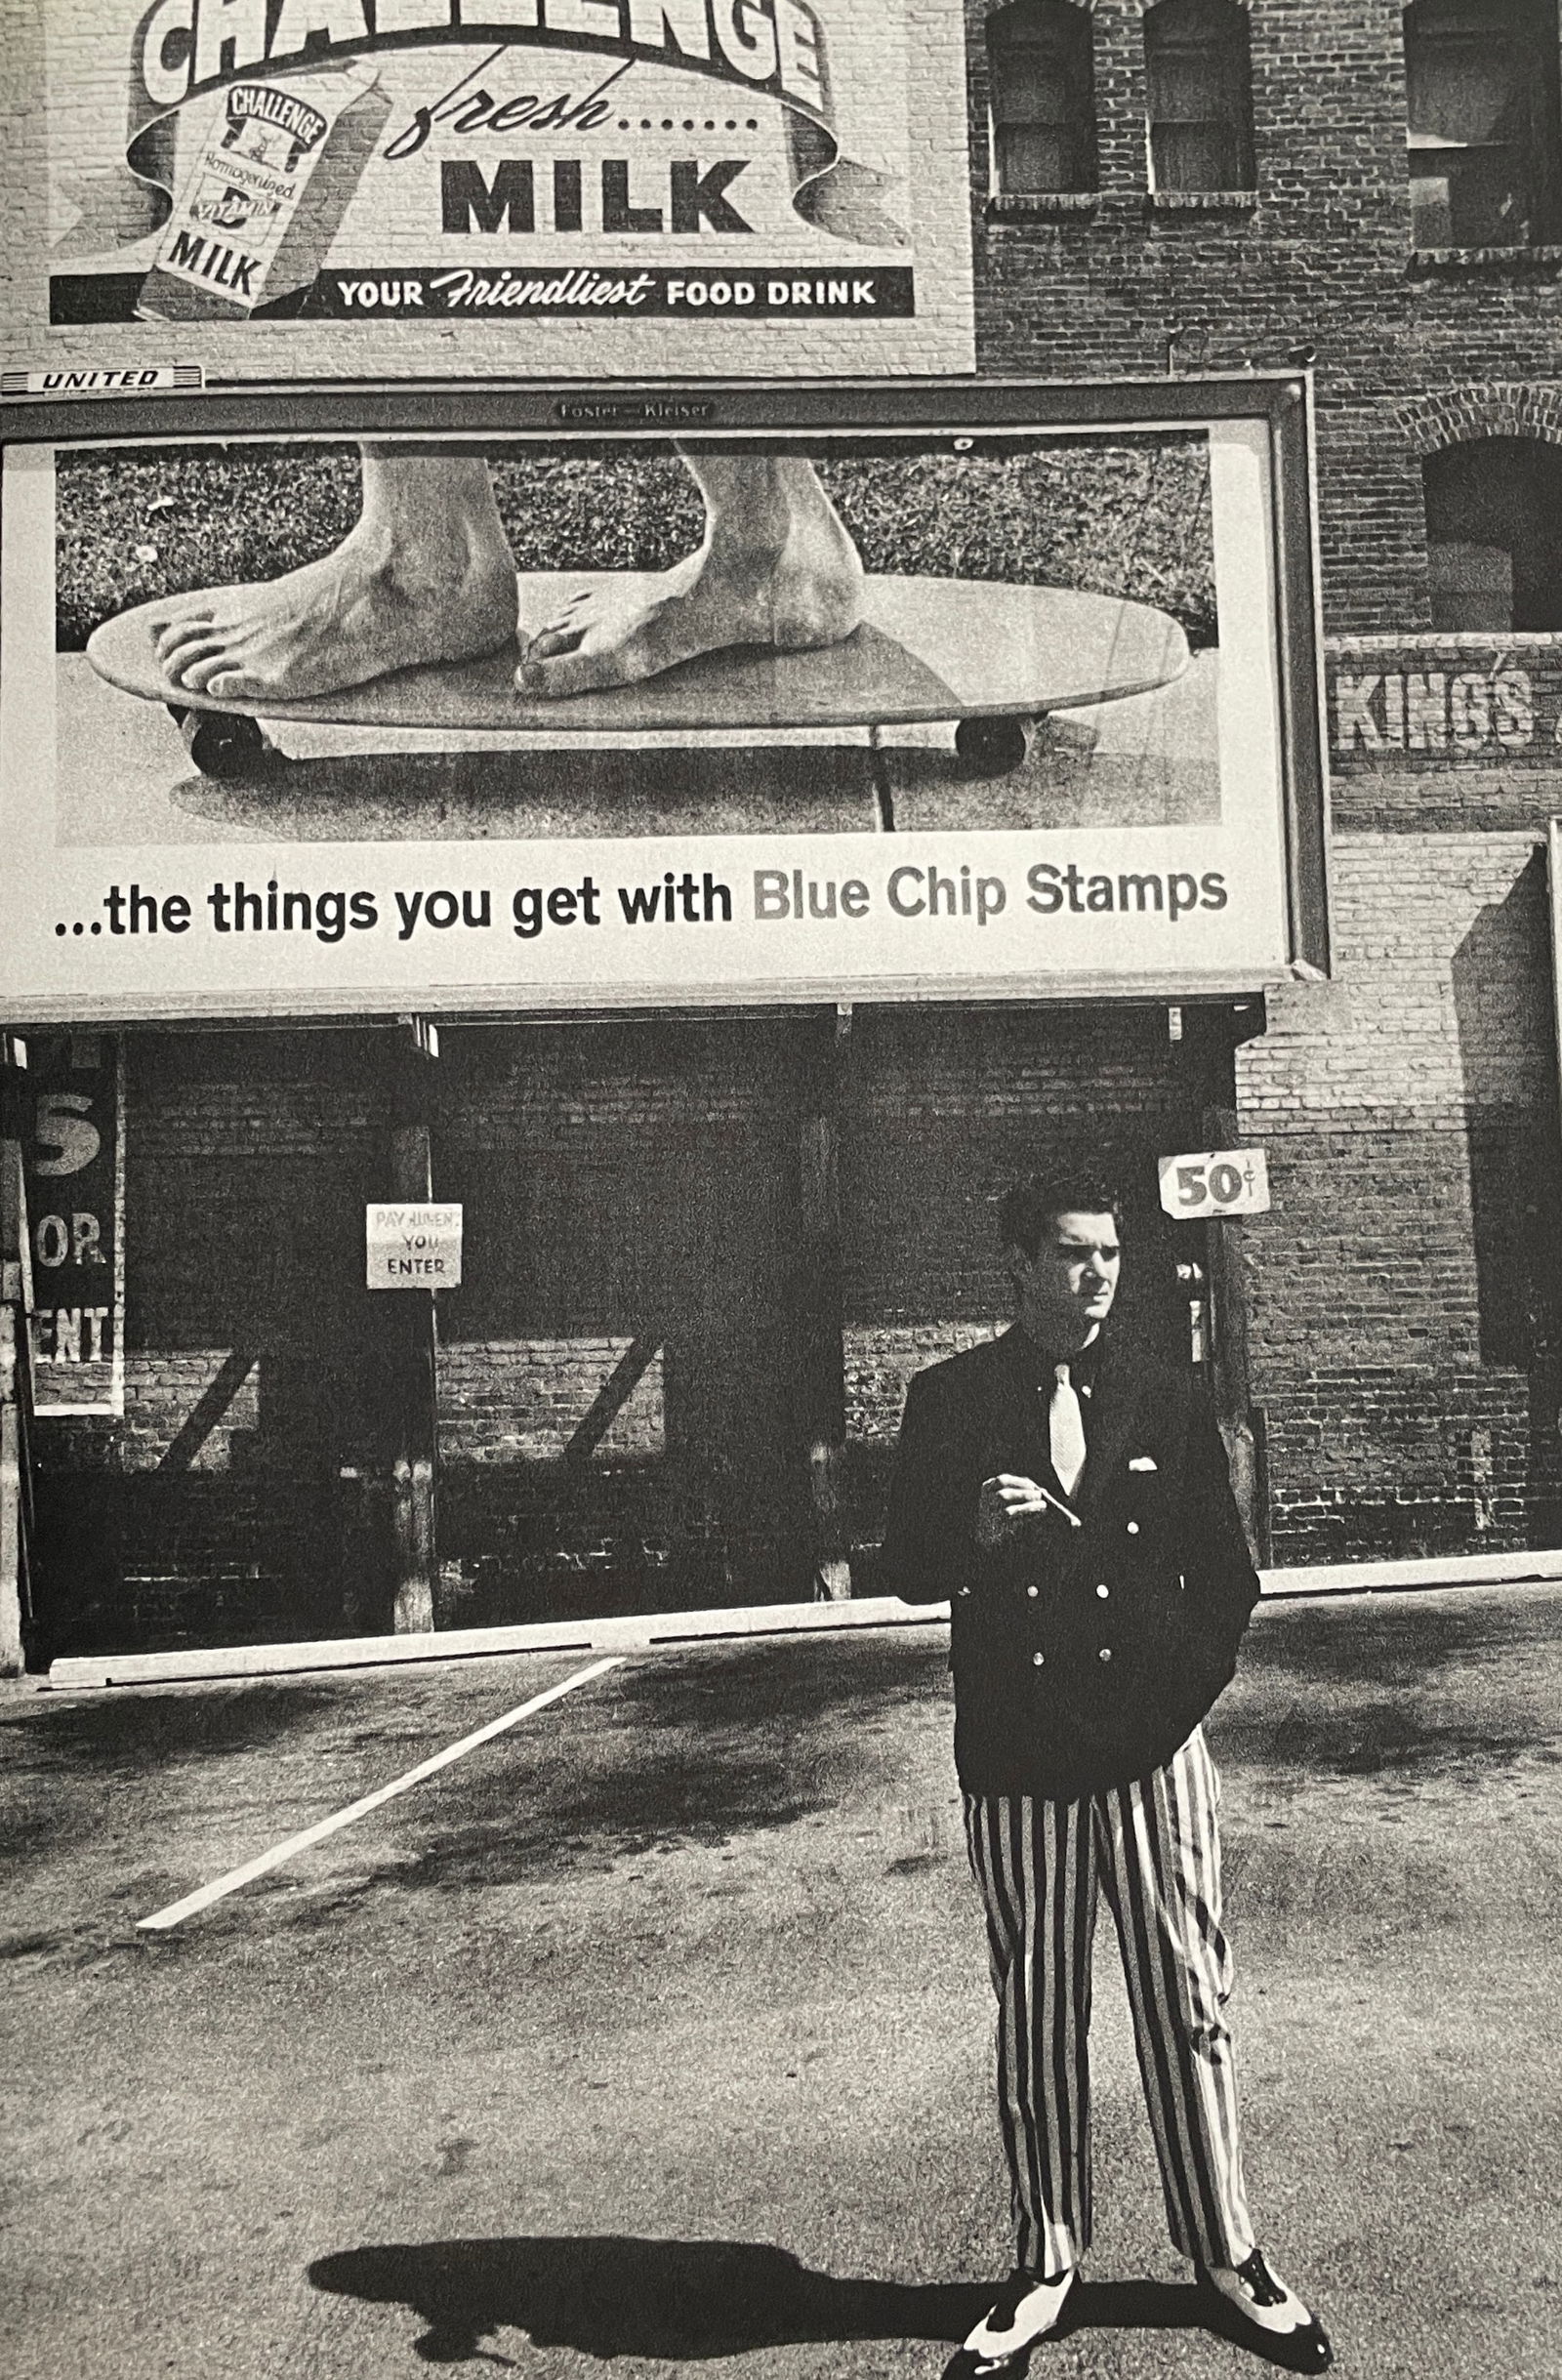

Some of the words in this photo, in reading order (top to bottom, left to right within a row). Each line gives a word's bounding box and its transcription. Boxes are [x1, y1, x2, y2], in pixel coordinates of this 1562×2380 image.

[143, 0, 824, 112] CHANGE
[231, 87, 325, 144] CHALLENGE
[198, 199, 277, 221] VITAMIN
[441, 159, 757, 234] MILK
[168, 230, 262, 296] MILK
[338, 280, 423, 307] YOUR
[431, 268, 655, 307] Friendliest
[668, 280, 756, 306] FOOD
[767, 279, 877, 306] DRINK
[43, 370, 158, 389] UNITED
[207, 879, 379, 943] things
[394, 888, 492, 940] you
[513, 877, 601, 938] get
[617, 872, 732, 924] with
[754, 869, 871, 921] Blue
[887, 865, 1007, 925] Chip
[1026, 863, 1228, 922] Stamps
[377, 1211, 405, 1227] PAY
[402, 1235, 438, 1251] YOU
[388, 1257, 445, 1274] ENTER
